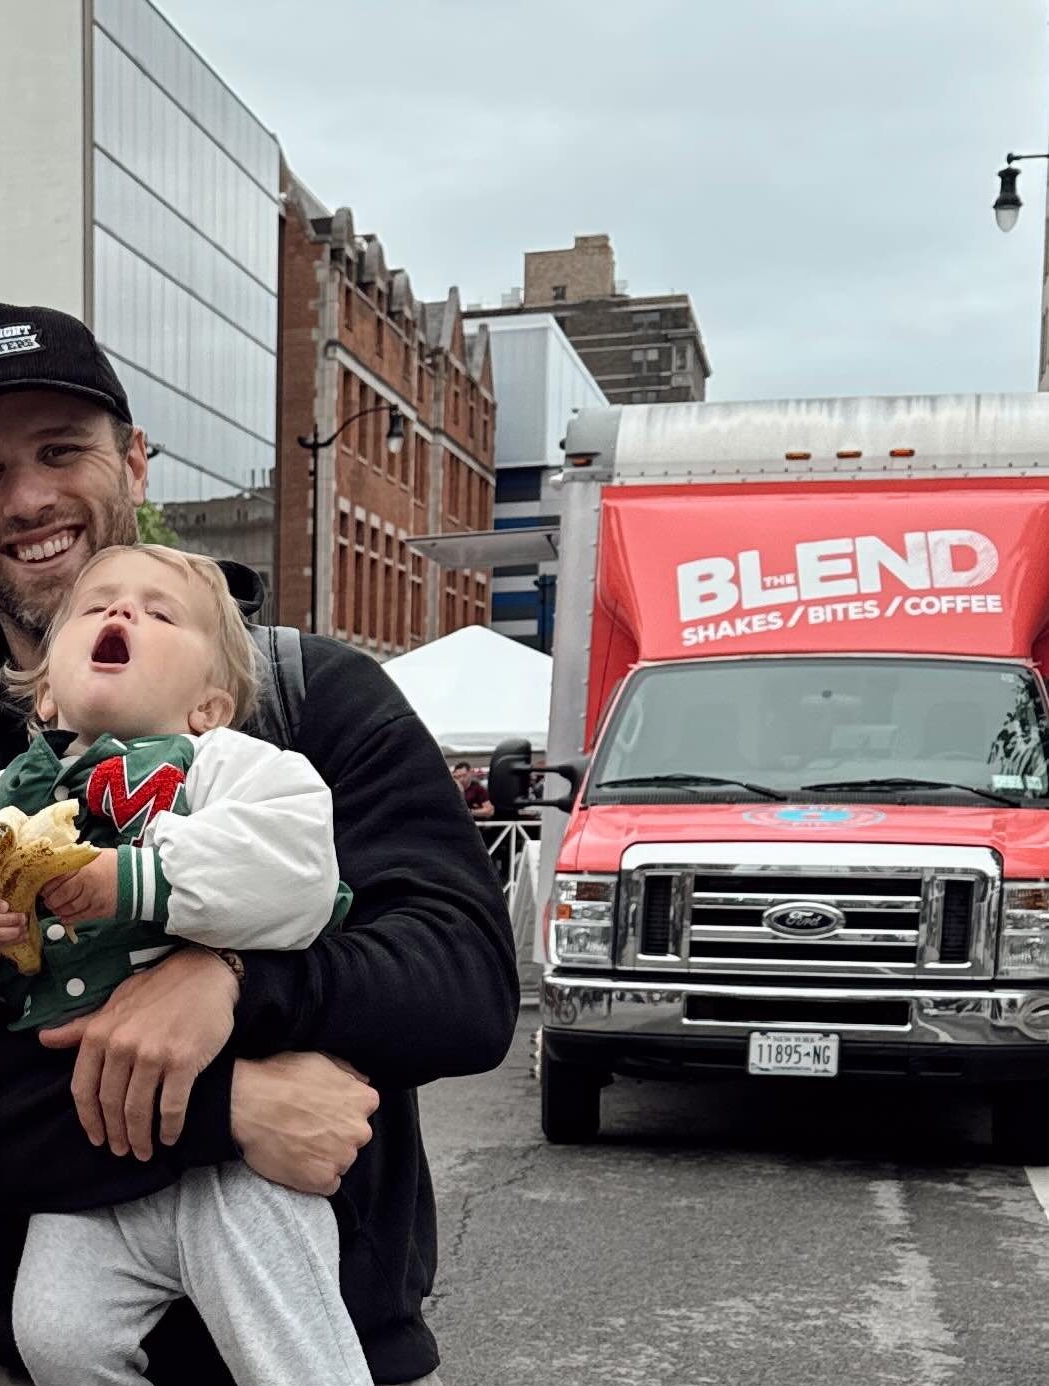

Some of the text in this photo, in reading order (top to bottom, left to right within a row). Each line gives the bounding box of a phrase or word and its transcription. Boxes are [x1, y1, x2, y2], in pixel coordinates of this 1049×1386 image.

[676, 529, 1000, 623] BLEND
[763, 573, 796, 588] THE
[681, 611, 784, 647] SHAKES
[807, 600, 881, 625] BITES
[904, 595, 1003, 616] COFFEE
[86, 755, 185, 849] M
[785, 910, 823, 927] Ford
